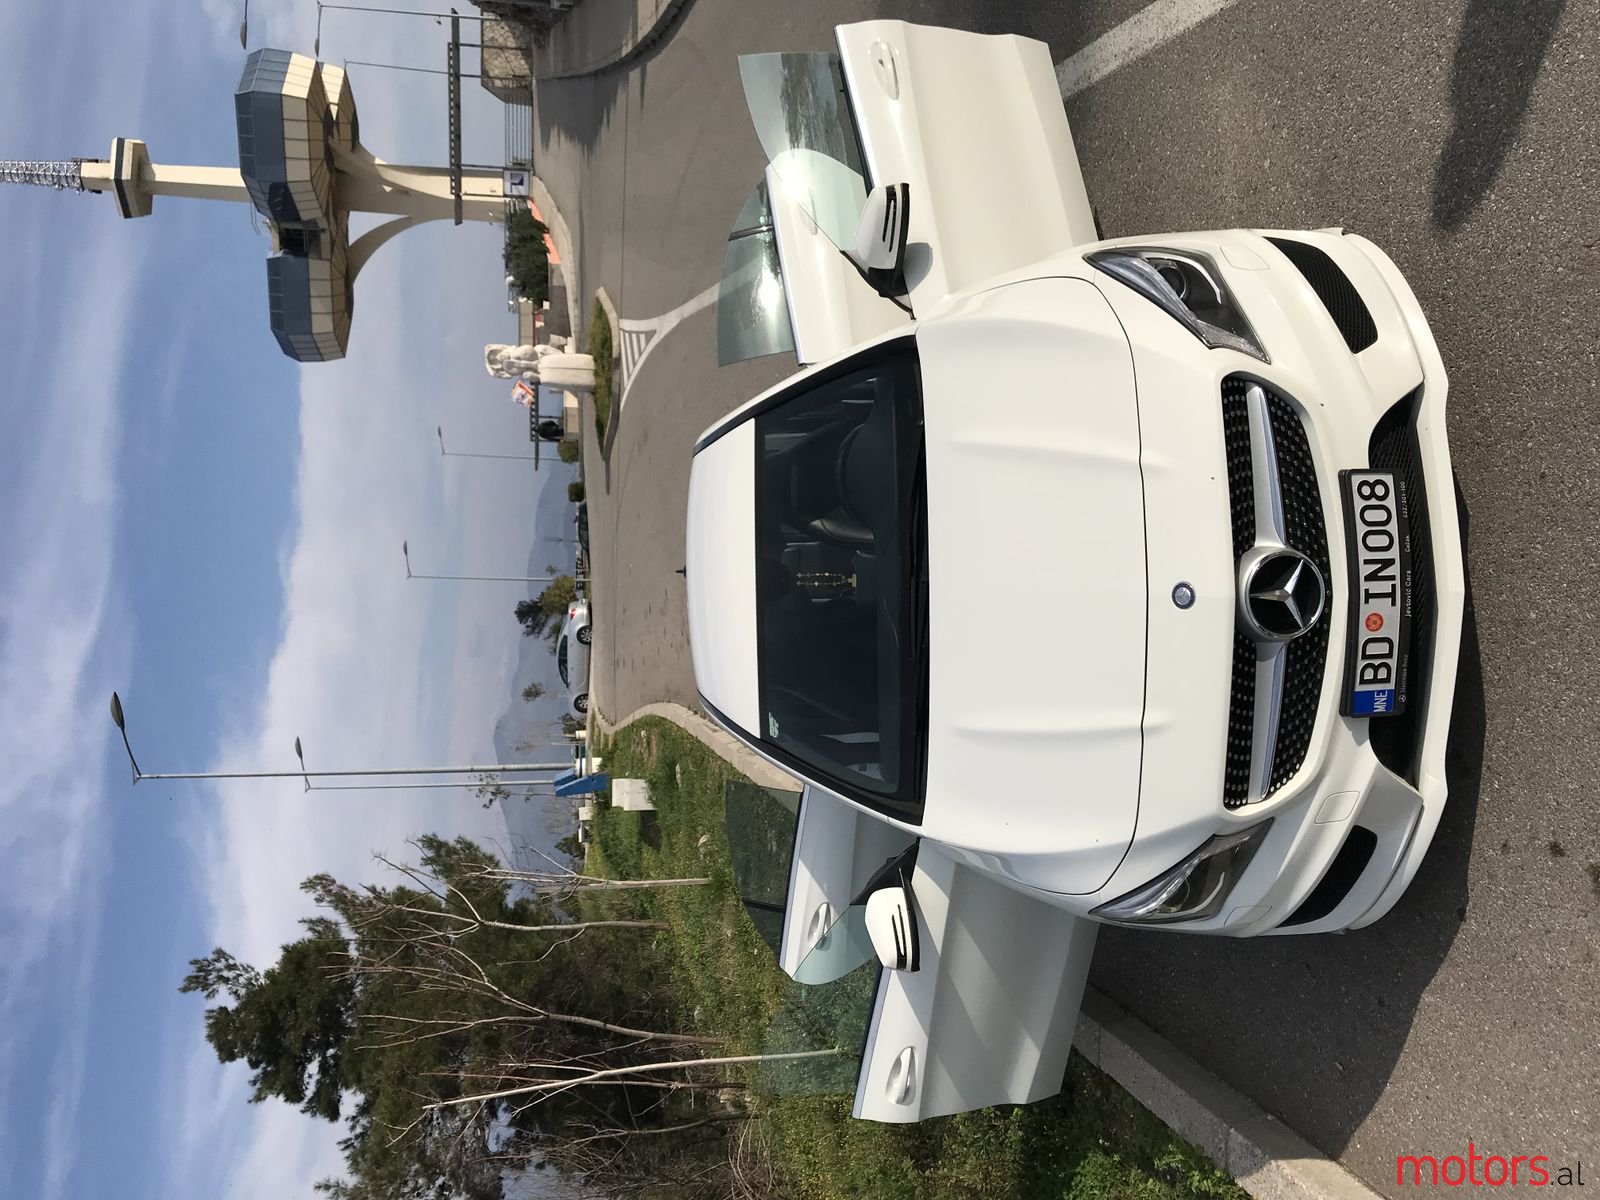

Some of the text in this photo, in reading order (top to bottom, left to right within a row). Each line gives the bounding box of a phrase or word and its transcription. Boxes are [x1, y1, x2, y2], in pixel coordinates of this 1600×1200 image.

[1357, 479, 1396, 686] BD IN008
[1404, 570, 1412, 587] Cars
[1373, 690, 1389, 712] MNE
